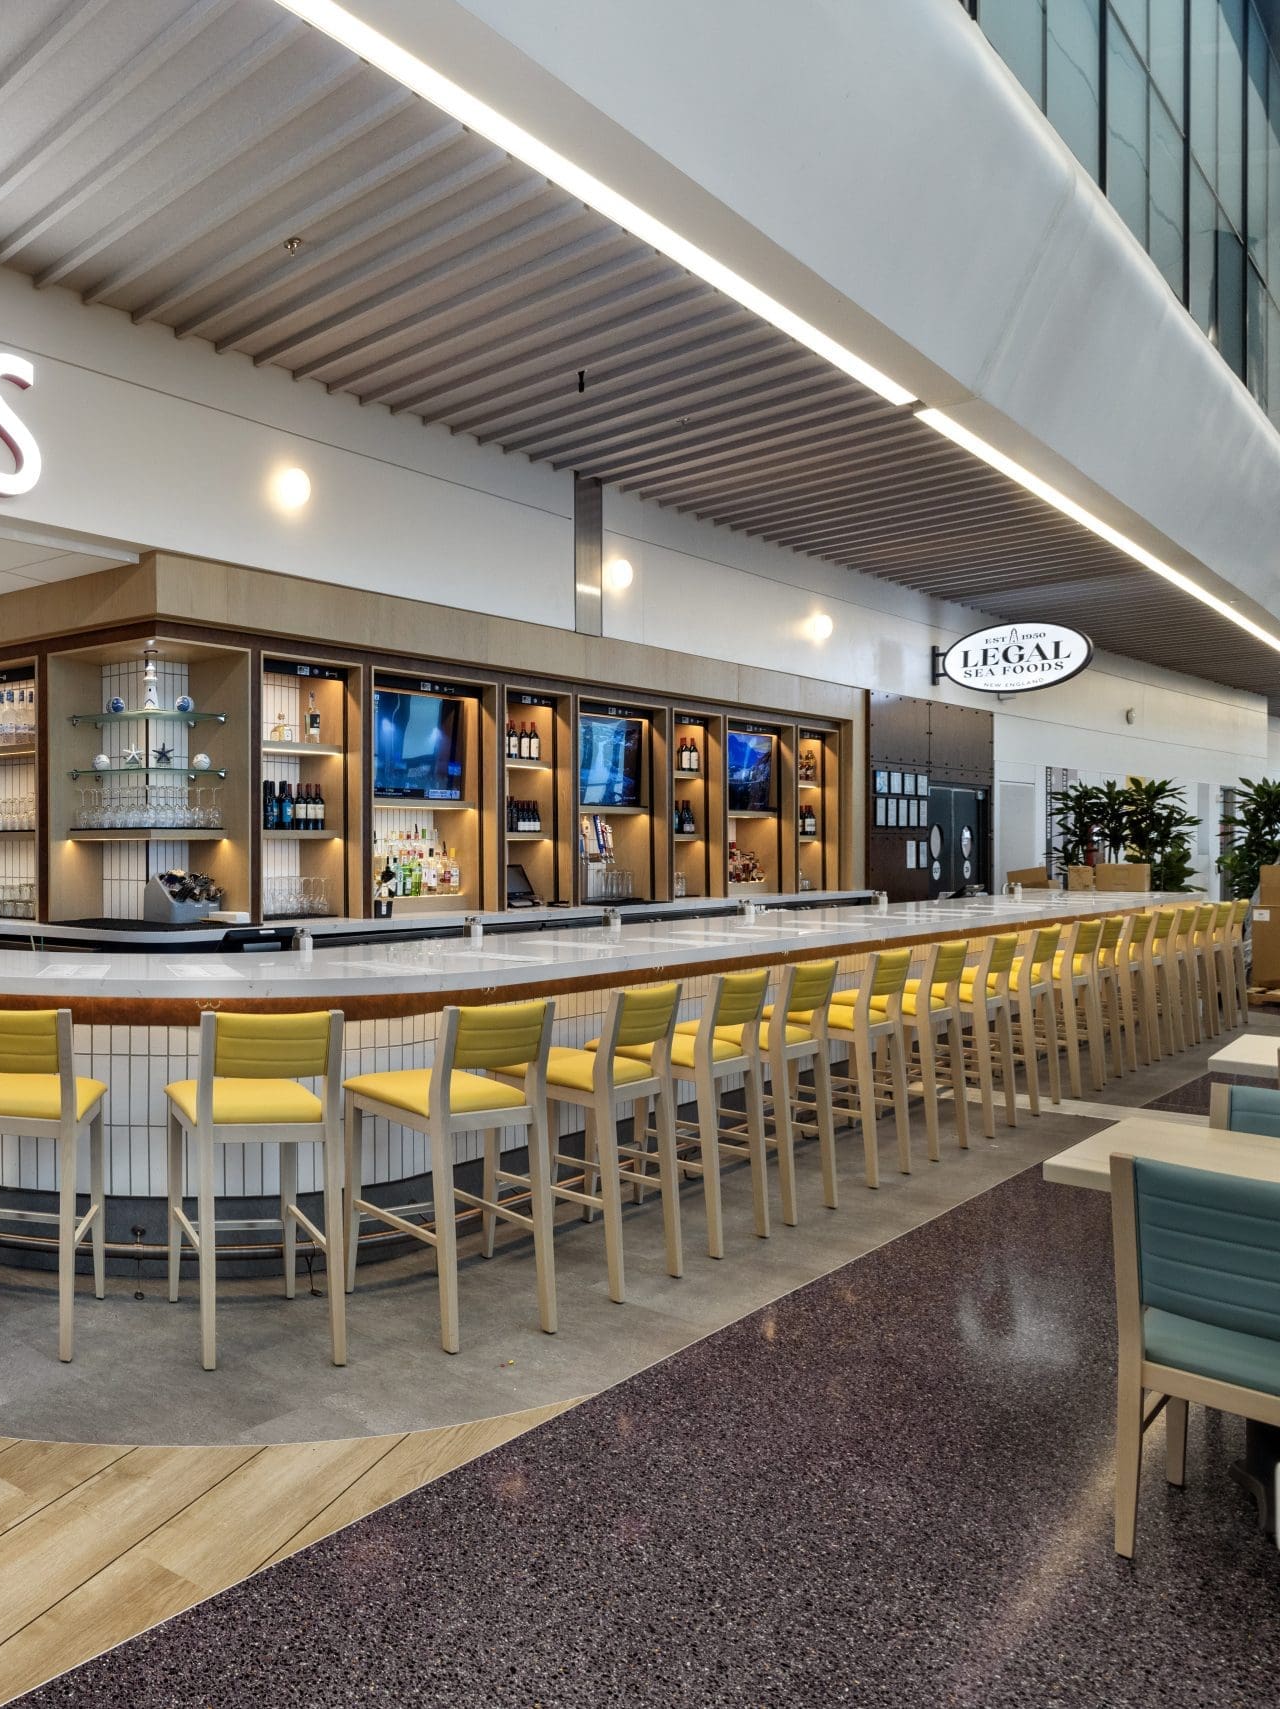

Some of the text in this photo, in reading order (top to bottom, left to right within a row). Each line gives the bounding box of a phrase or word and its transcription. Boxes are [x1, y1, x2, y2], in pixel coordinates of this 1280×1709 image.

[984, 632, 1046, 645] EST 1950
[961, 640, 1071, 668] LEGAL
[963, 661, 1064, 678] SEA FOODS
[1004, 677, 1044, 687] ENGLAND
